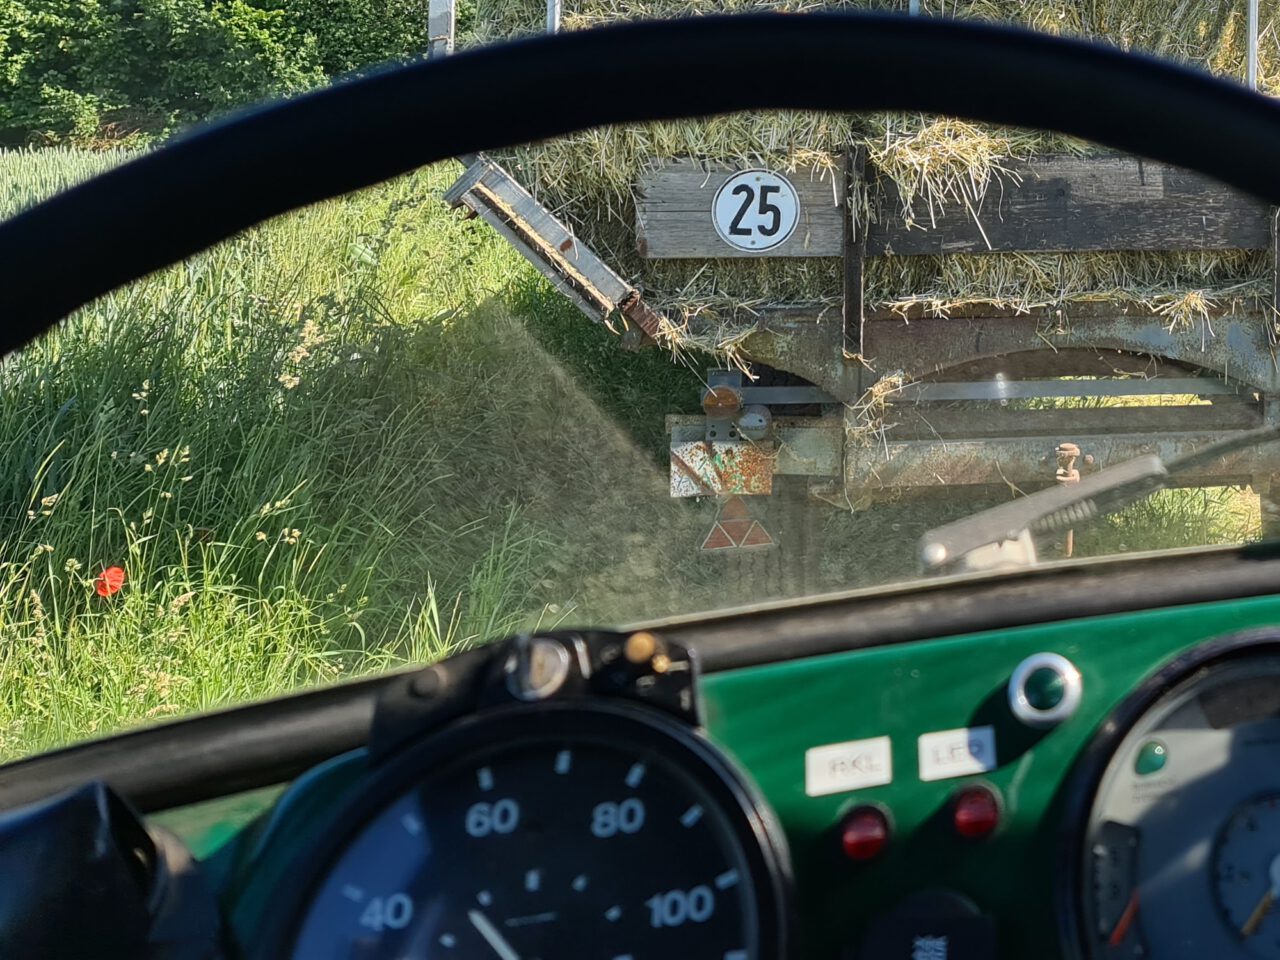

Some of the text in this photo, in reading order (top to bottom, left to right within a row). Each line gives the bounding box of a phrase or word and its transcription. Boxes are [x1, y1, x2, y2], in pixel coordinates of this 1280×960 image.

[728, 184, 781, 237] 25
[465, 797, 520, 838] 60
[591, 796, 646, 838] 80
[359, 892, 414, 931] 40
[645, 885, 715, 929] 100
